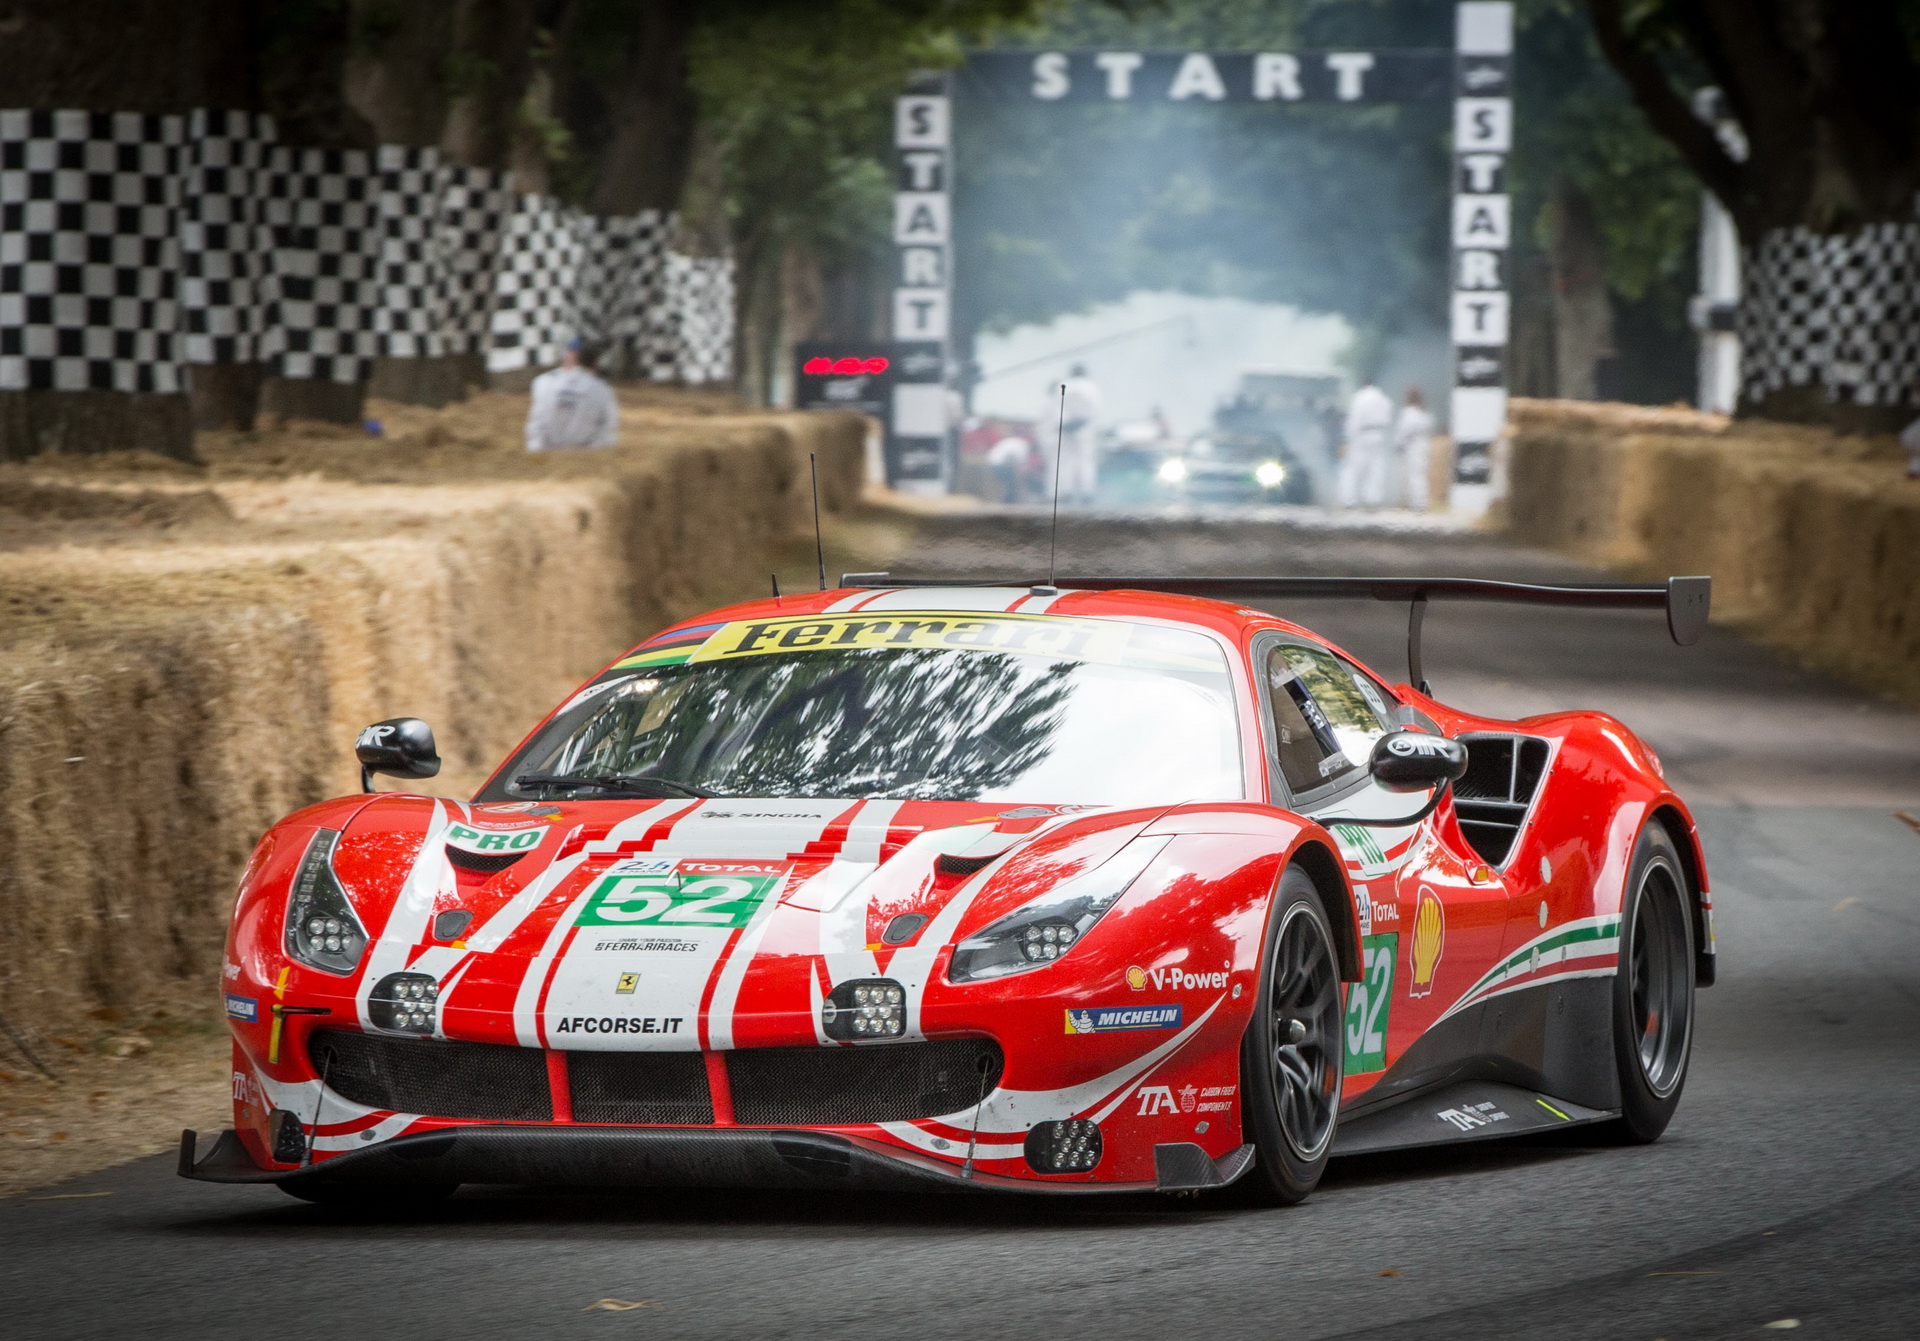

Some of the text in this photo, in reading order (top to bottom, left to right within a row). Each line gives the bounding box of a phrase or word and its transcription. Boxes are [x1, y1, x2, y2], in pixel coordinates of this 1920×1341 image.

[1031, 51, 1376, 99] START
[903, 105, 941, 329] START
[1462, 109, 1503, 331] START
[723, 620, 1100, 657] Ferrari
[449, 825, 541, 850] PRO
[682, 863, 782, 873] TOTAL
[596, 877, 753, 923] 52
[1371, 900, 1399, 922] TOTAL
[1150, 967, 1229, 990] V-Power
[1347, 947, 1392, 1056] 52
[557, 1017, 683, 1034] AFCORSE.IT
[1097, 1009, 1178, 1026] MICHELIN
